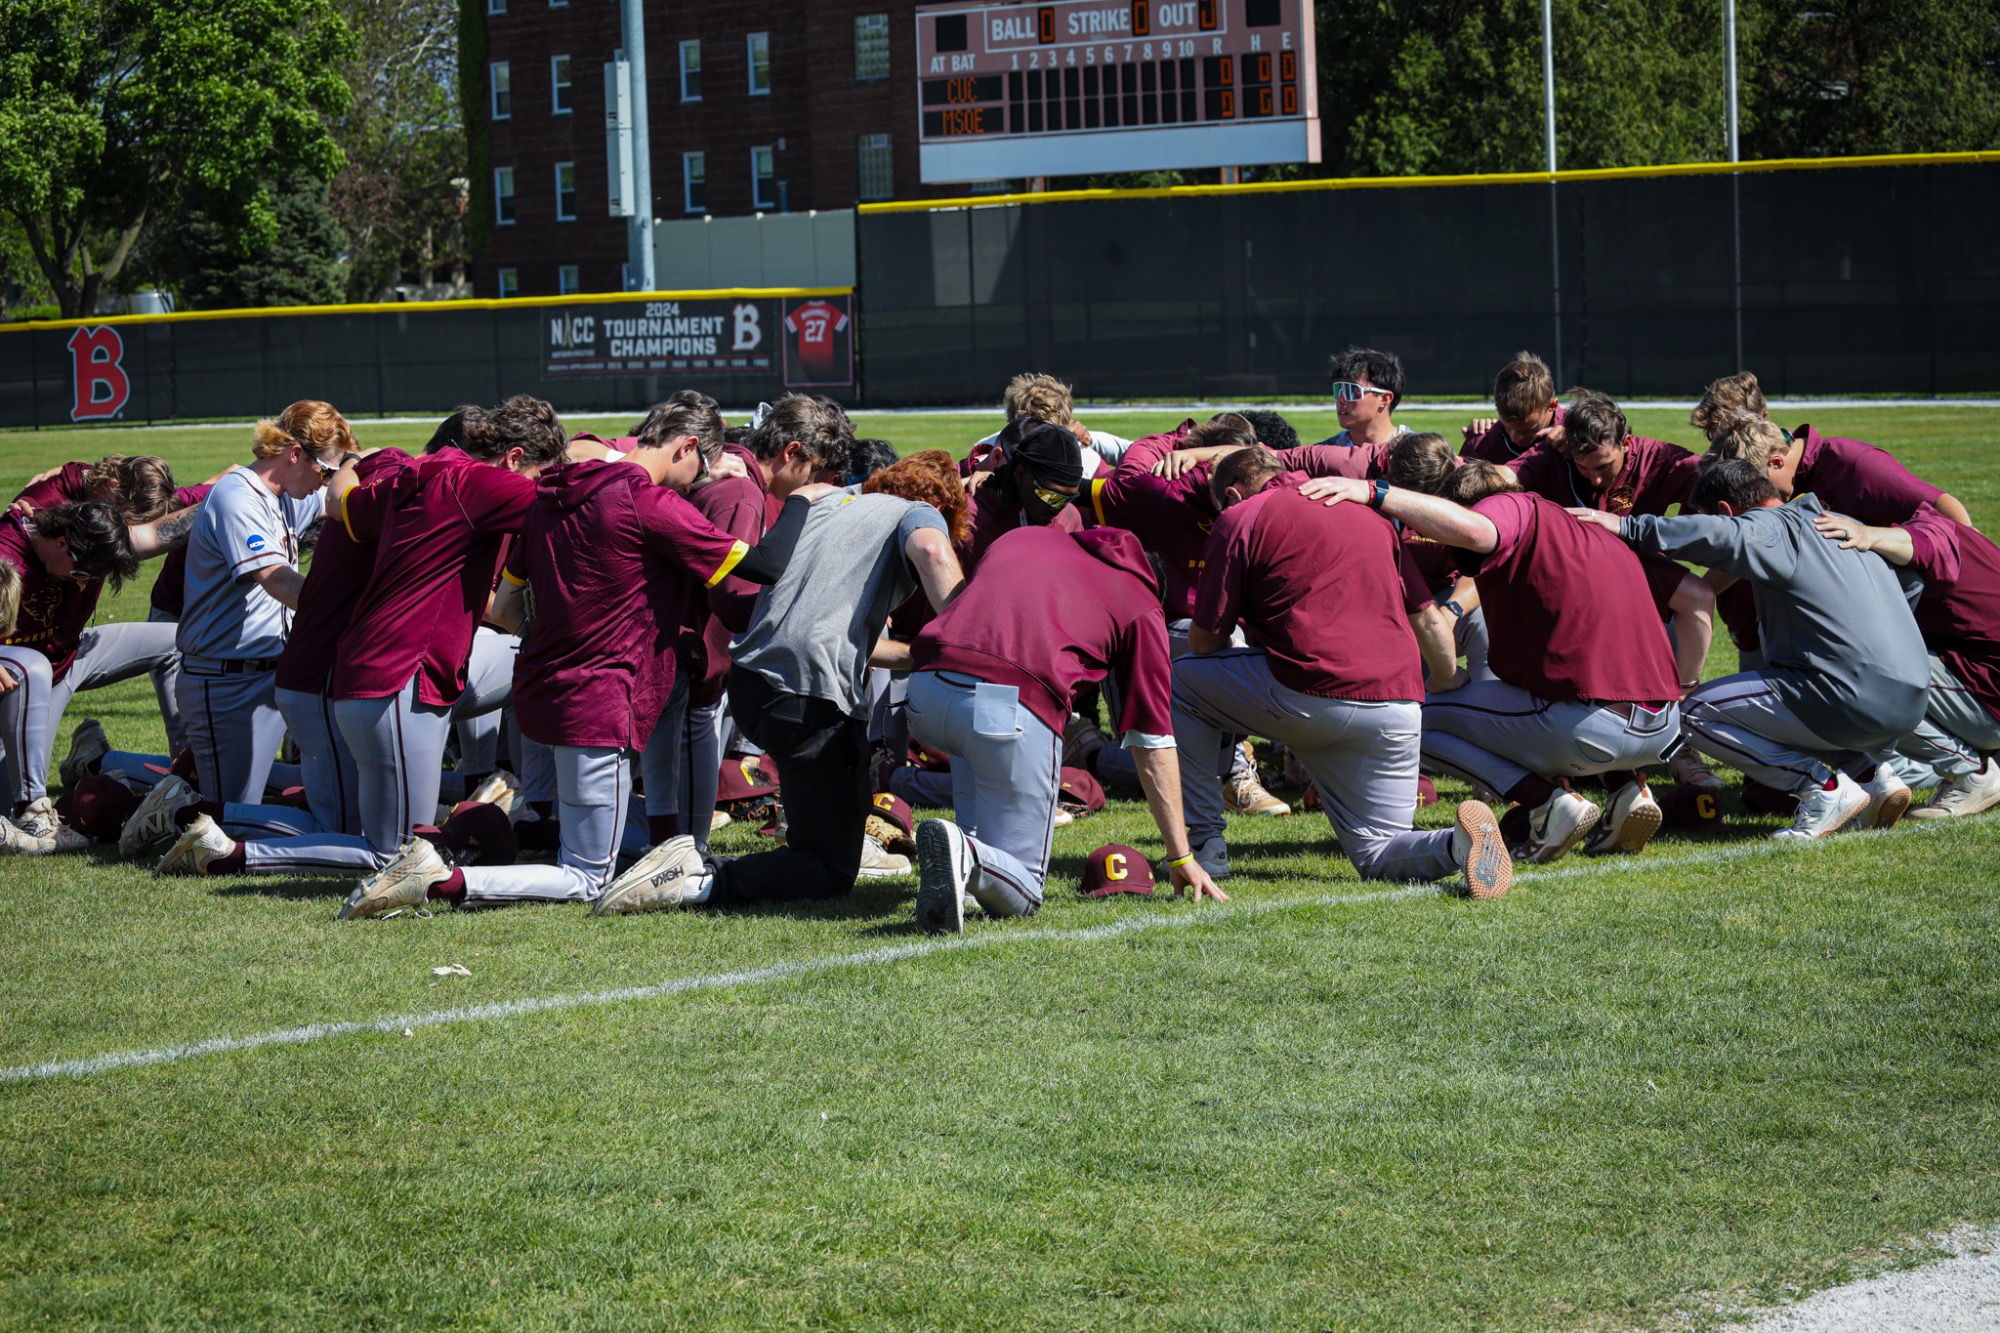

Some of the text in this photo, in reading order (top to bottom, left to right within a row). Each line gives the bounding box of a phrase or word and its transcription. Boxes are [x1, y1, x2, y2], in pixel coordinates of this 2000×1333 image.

[991, 16, 1036, 42] BALL
[1068, 8, 1131, 36] STRIKE
[1159, 2, 1196, 28] OUT
[930, 53, 976, 73] AT BAT
[1011, 32, 1292, 70] 1 2 3 4 5 6 7 8 9 10 R H E
[947, 77, 977, 104] CUC
[942, 108, 985, 136] MSOE
[646, 302, 679, 317] 2024
[603, 315, 725, 338] TOURNAMENT
[732, 303, 762, 350] B
[804, 319, 827, 342] 27
[610, 337, 717, 357] CHAMPIONS
[66, 324, 130, 422] B
[1696, 794, 1716, 819] C
[650, 865, 684, 888] HOKA
[1105, 853, 1128, 881] C
